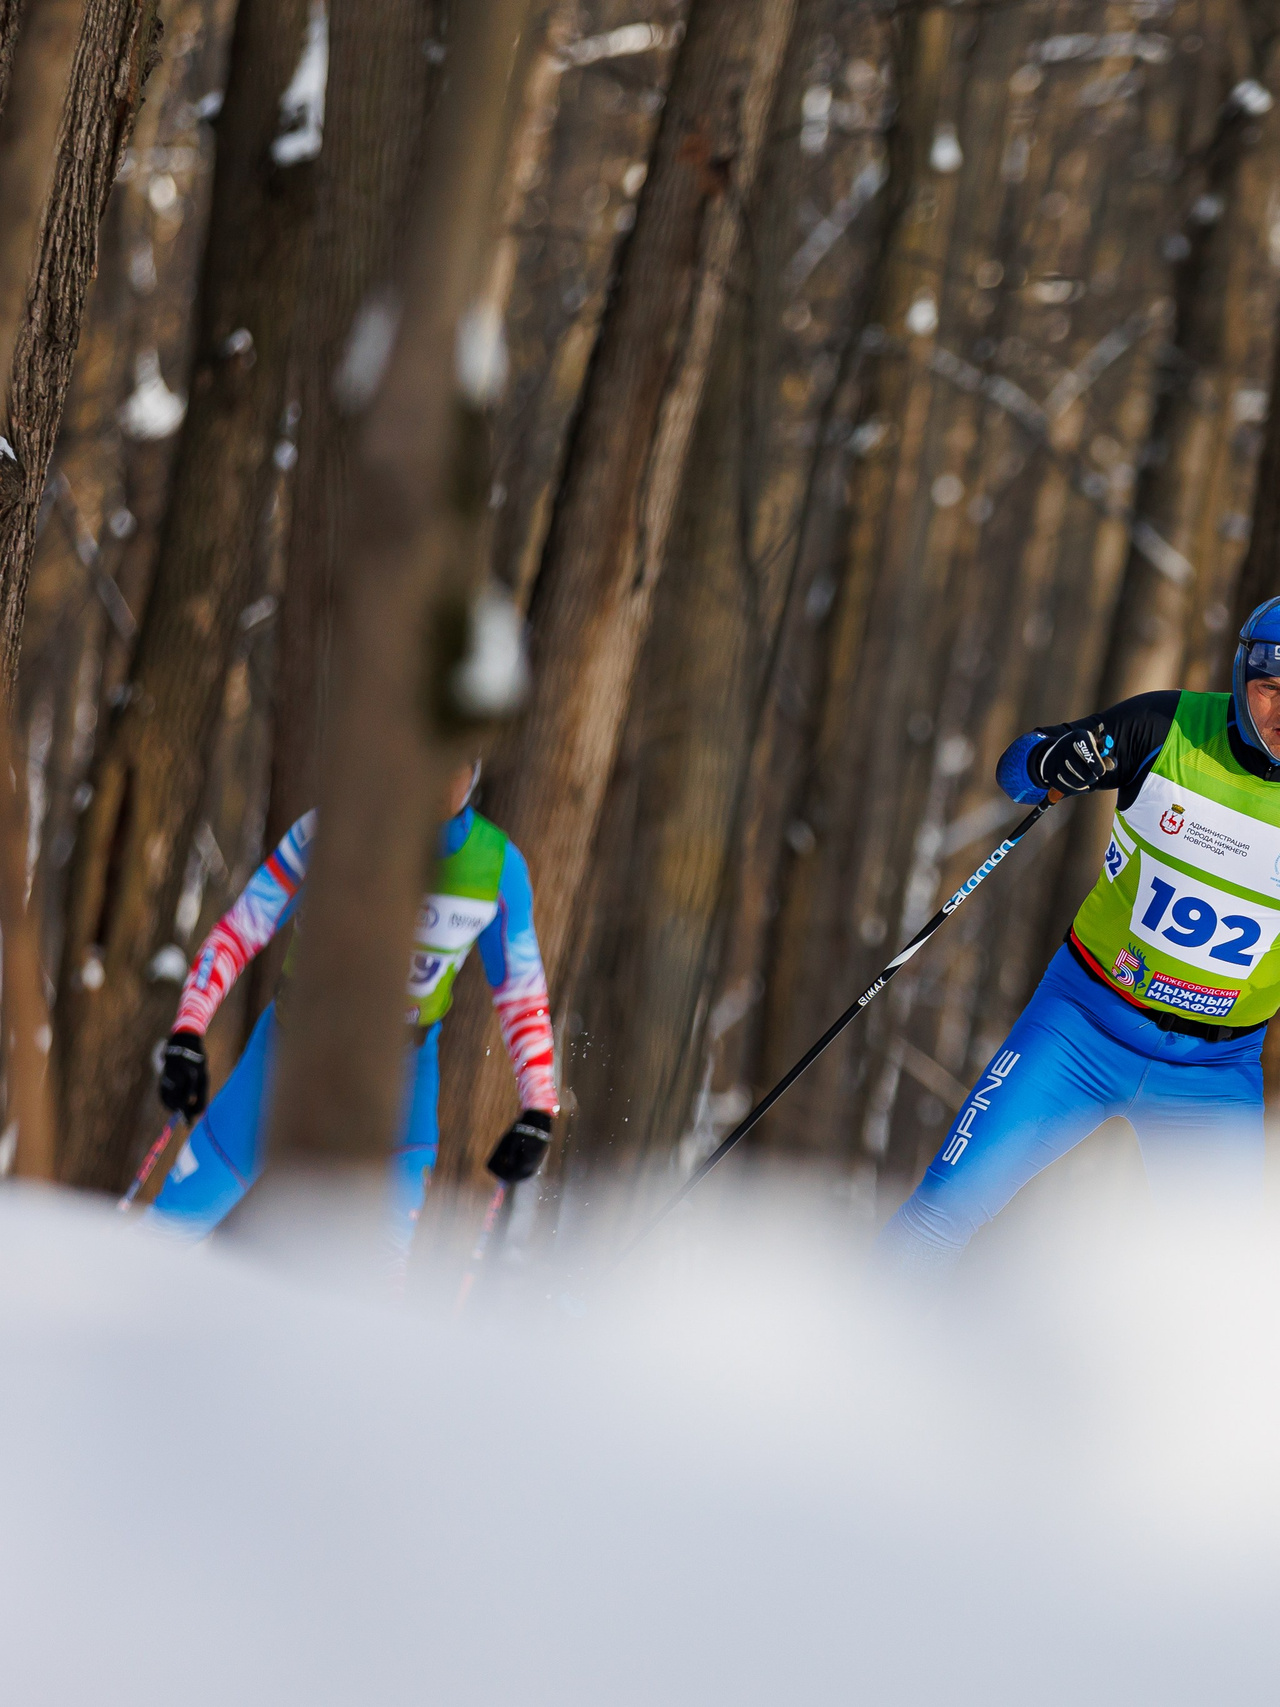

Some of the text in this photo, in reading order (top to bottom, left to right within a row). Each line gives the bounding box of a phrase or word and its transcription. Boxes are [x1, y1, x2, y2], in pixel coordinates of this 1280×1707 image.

[1183, 834, 1225, 856] НОВГОРОДА
[1186, 827, 1248, 857] ГОРОДА НИЖНЕГО
[1189, 821, 1250, 850] АДМИНИСТРАЦИЯ
[1141, 876, 1261, 967] 192
[1150, 980, 1235, 1008] ЛЫЖНЫЙ
[1155, 973, 1239, 997] НИЖЕГОРОДСКИЙ
[1147, 989, 1229, 1016] МАРАФОН
[941, 1049, 1021, 1166] SPINE
